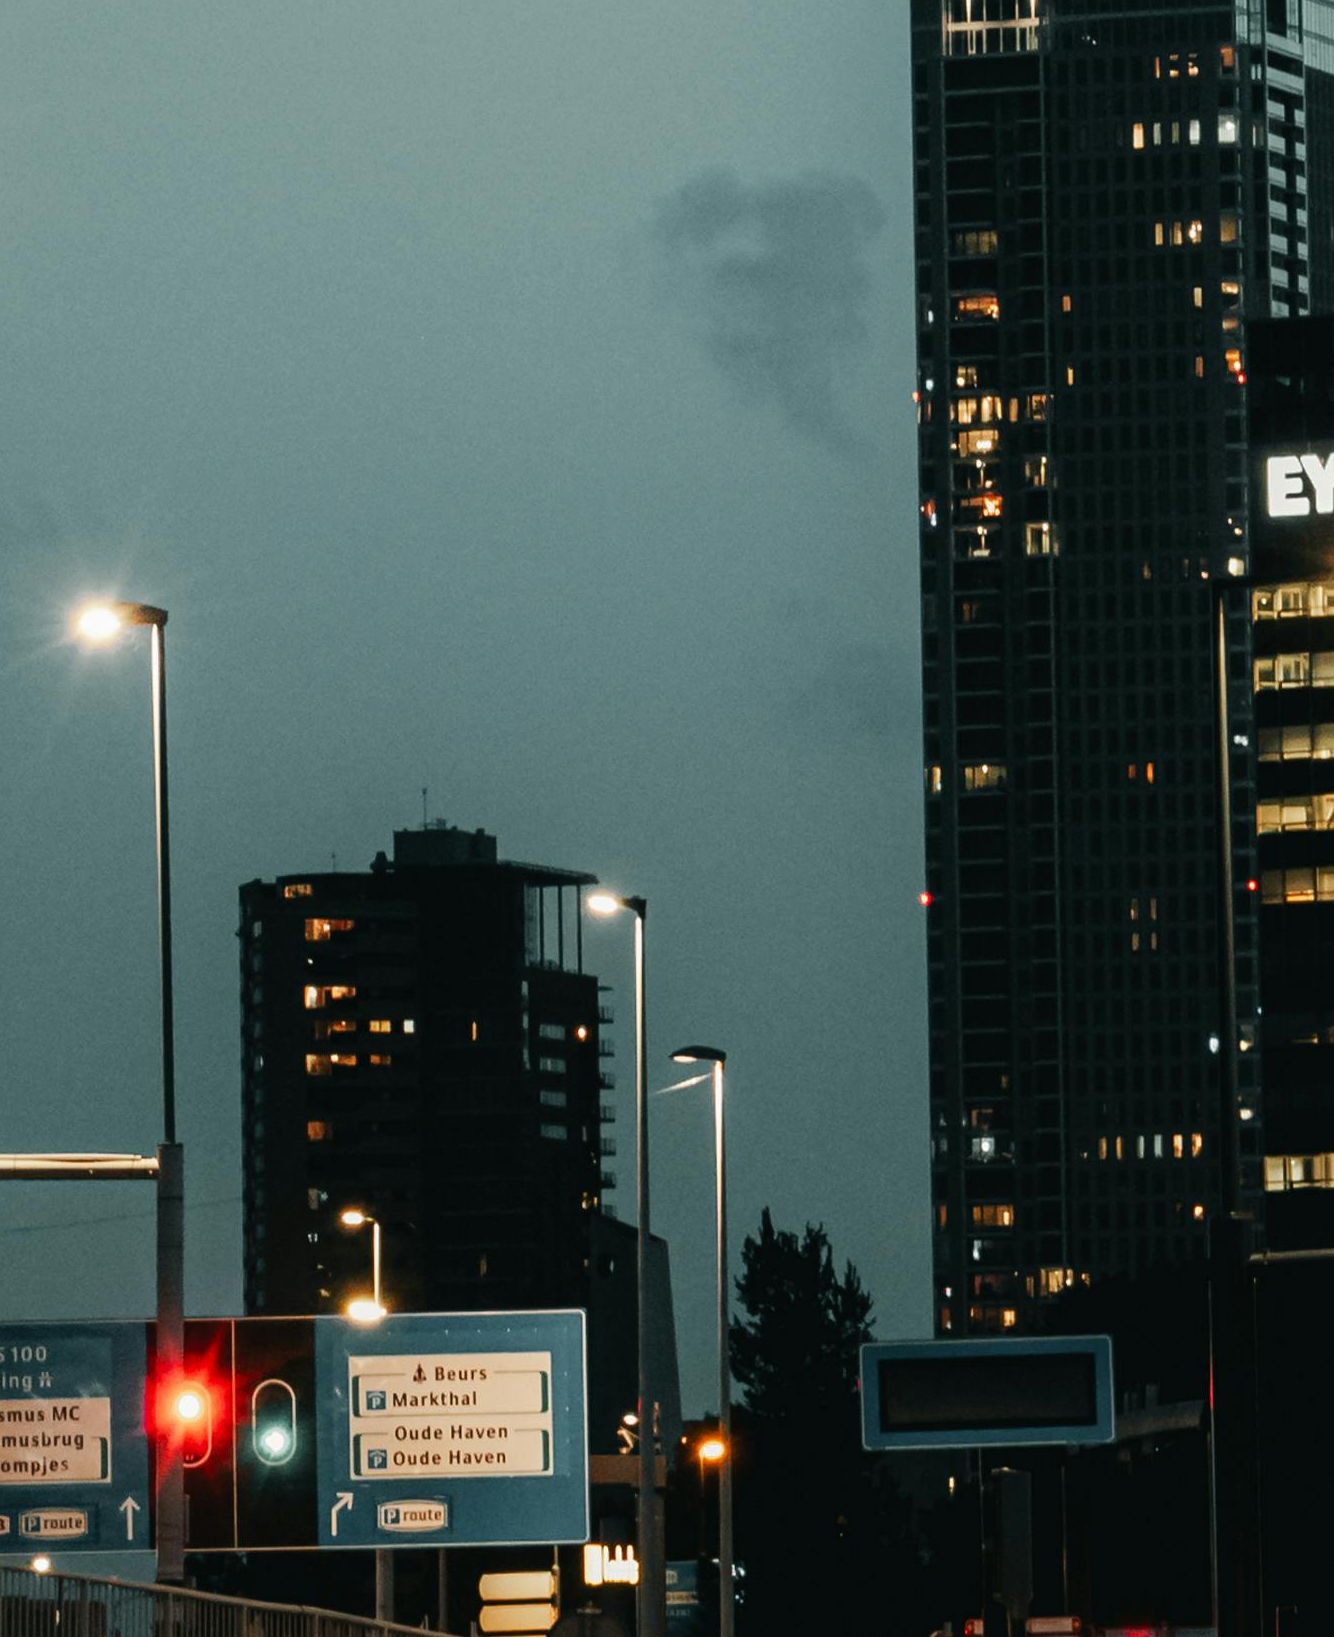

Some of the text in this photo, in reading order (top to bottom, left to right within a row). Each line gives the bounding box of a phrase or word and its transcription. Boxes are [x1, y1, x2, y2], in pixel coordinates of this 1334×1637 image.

[434, 1366, 488, 1382] Beurs
[392, 1391, 478, 1407] Markthal
[52, 1405, 80, 1422] MC
[394, 1424, 509, 1441] Oude Haven
[392, 1450, 442, 1466] Oude
[448, 1449, 507, 1465] Haven
[403, 1509, 442, 1521] route
[43, 1517, 83, 1530] route
